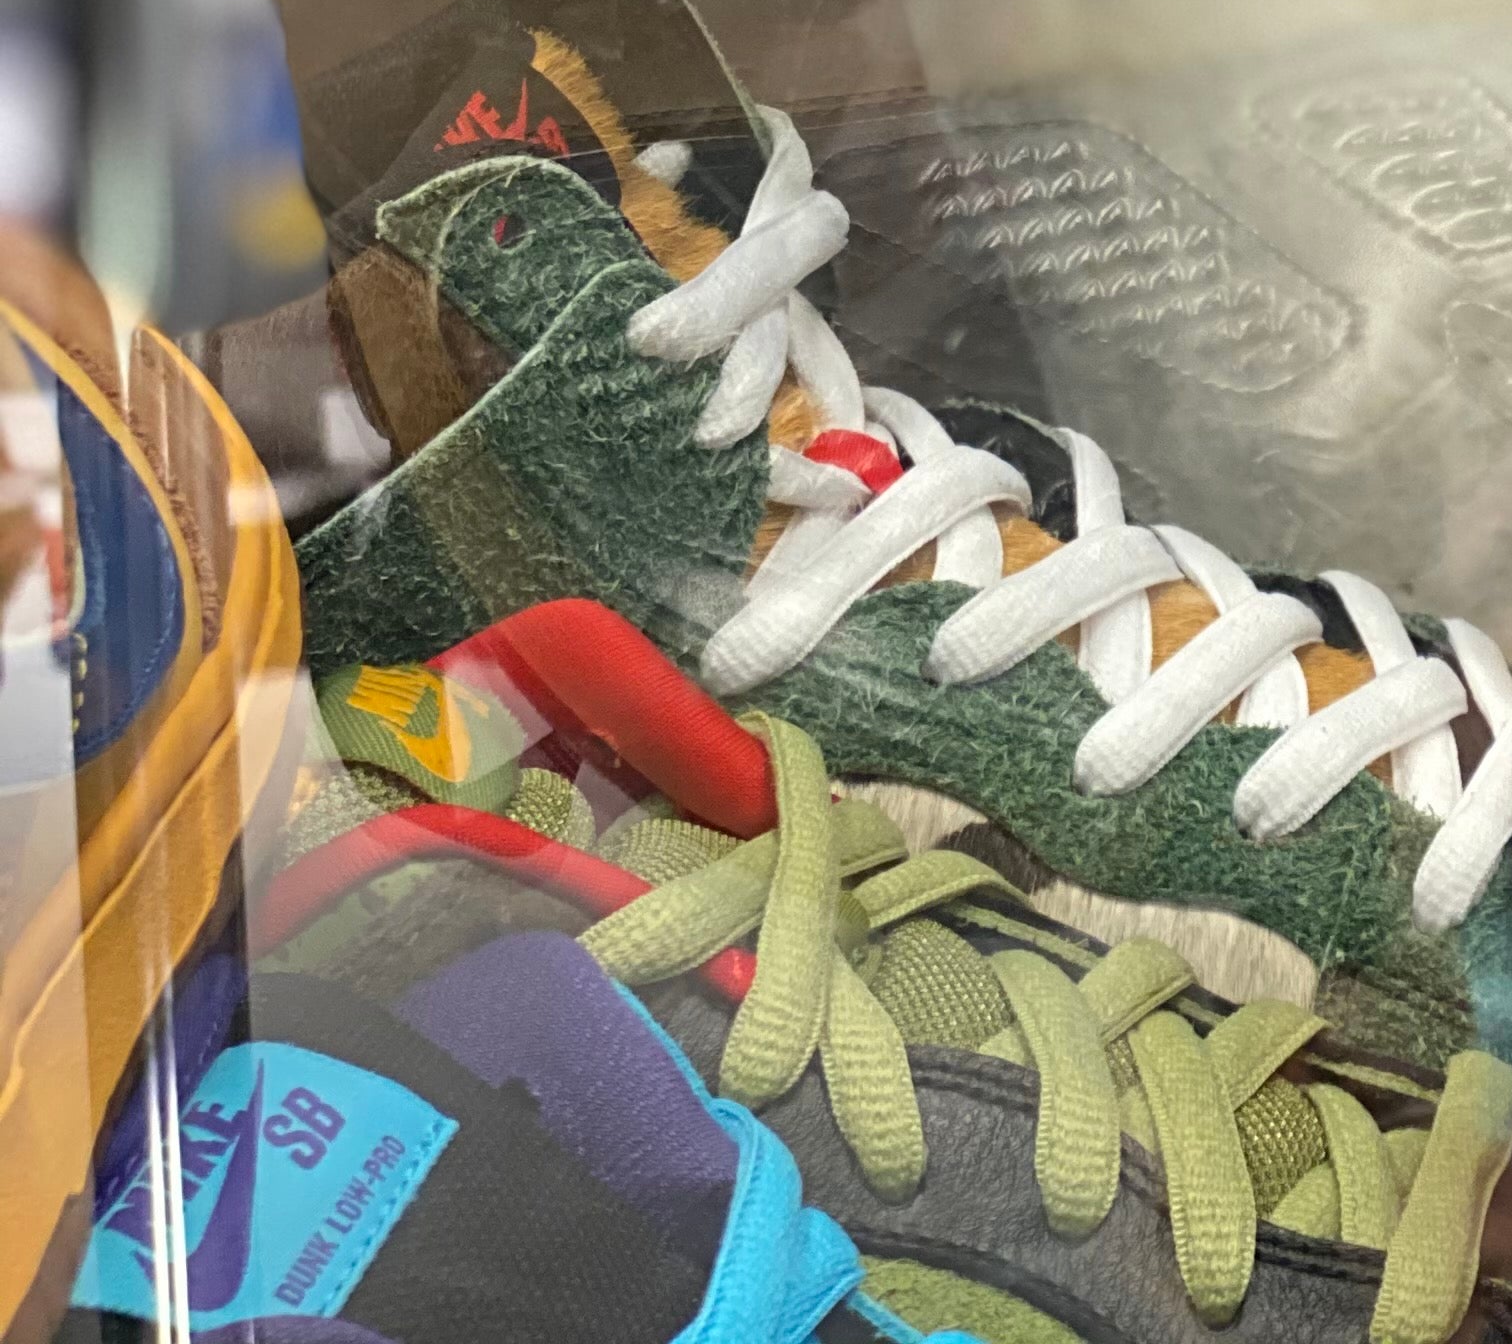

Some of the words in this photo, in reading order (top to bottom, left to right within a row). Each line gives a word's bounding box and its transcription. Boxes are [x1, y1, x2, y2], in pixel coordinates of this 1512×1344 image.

[262, 1086, 346, 1170] SB
[273, 1231, 340, 1308] DUNK
[324, 1135, 406, 1235] LOW-PRO
